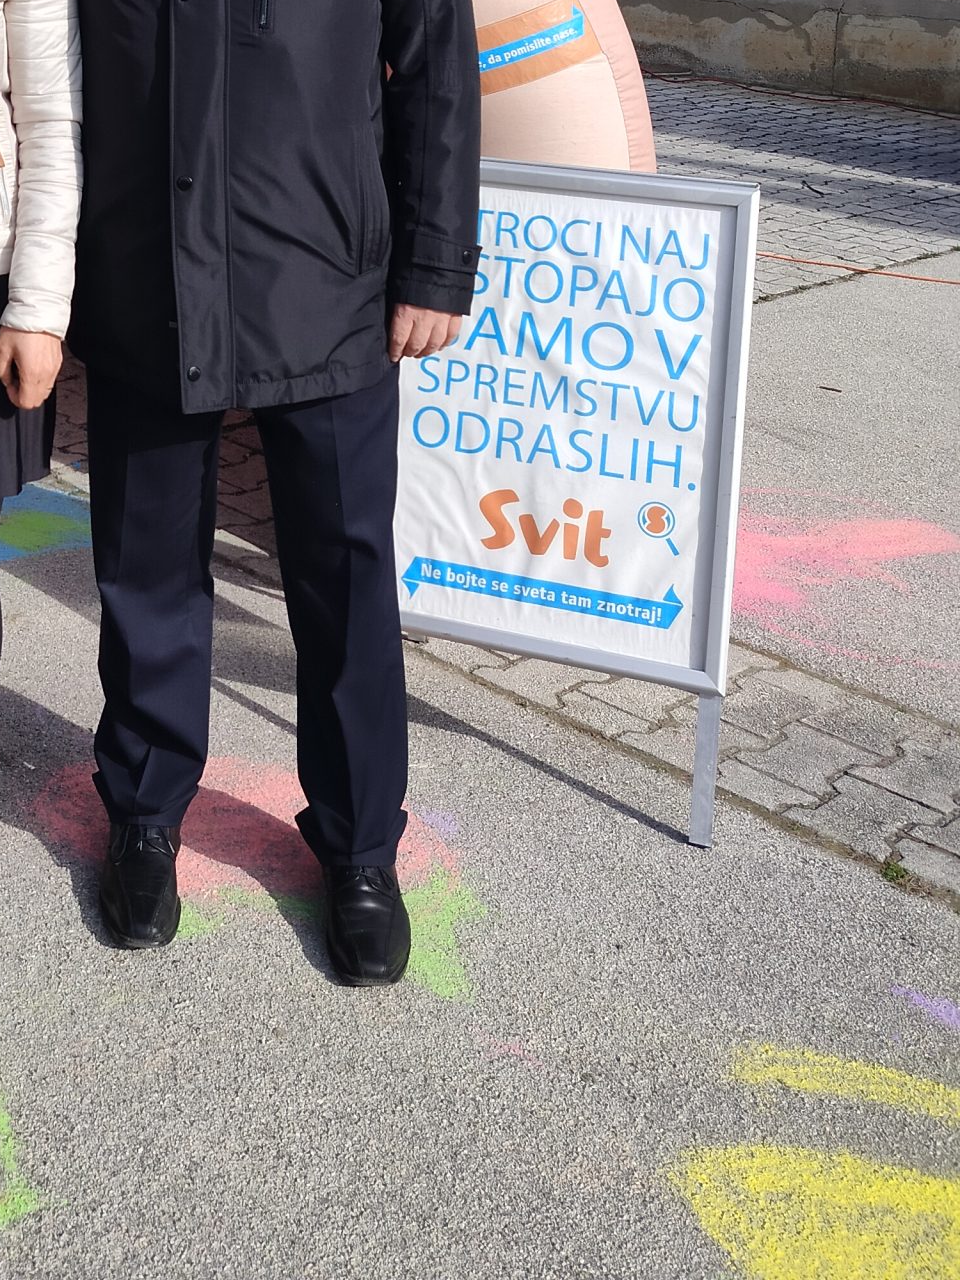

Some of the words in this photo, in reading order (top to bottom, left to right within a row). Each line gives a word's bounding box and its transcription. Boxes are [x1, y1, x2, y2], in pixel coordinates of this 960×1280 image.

[487, 53, 502, 65] da
[503, 35, 552, 62] pomislite
[475, 209, 602, 258] TROCI
[620, 224, 710, 271] NAJ
[471, 252, 706, 323] STOPAJO
[442, 305, 635, 372] AMO
[656, 329, 703, 380] V
[416, 355, 700, 433] SPREMSTVU
[411, 404, 698, 492] ODRASLIH.
[478, 488, 612, 569] Svit
[420, 562, 441, 580] Ne
[446, 567, 487, 589] bojte
[491, 579, 510, 593] se
[513, 583, 556, 602] sveta
[561, 591, 592, 610] tam
[596, 599, 663, 625] znotraj!
